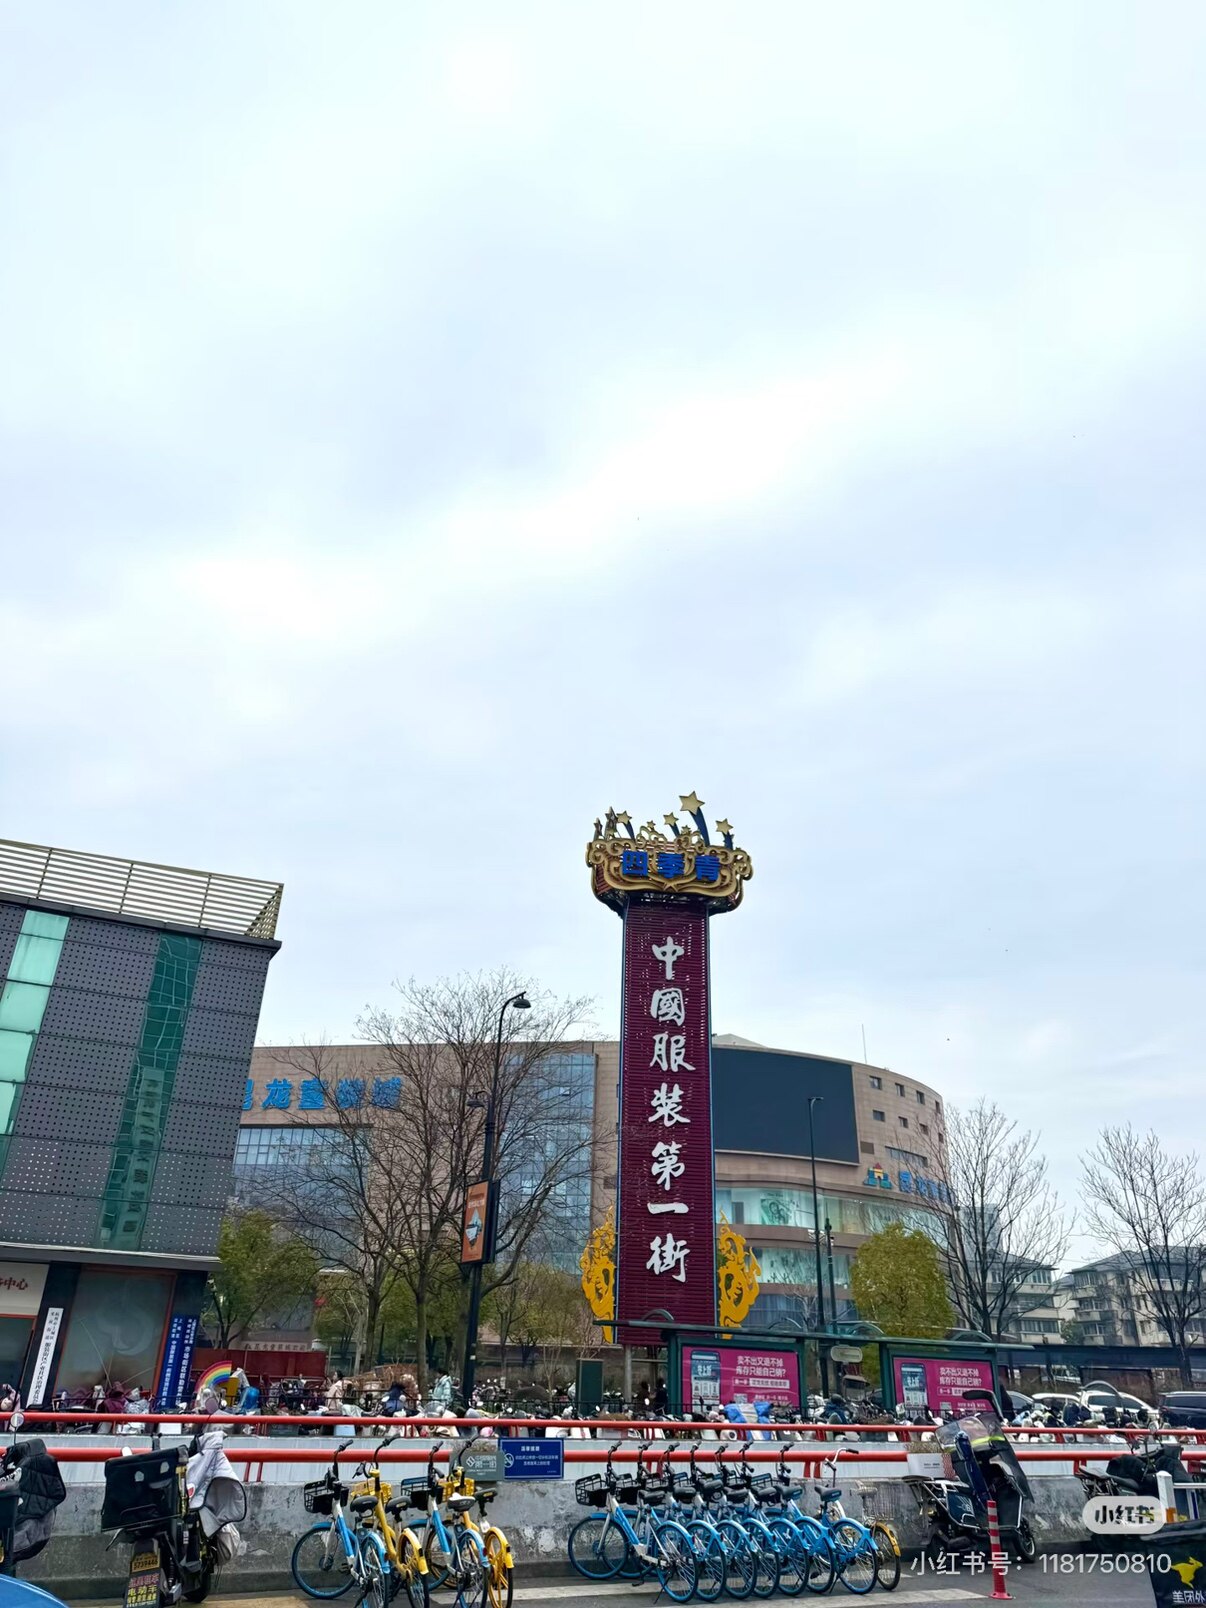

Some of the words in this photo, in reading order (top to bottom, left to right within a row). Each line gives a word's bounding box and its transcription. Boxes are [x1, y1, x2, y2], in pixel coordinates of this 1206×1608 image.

[621, 849, 721, 882] 四季青
[0, 1276, 29, 1291] 中心
[1172, 1590, 1206, 1604] 美团外
